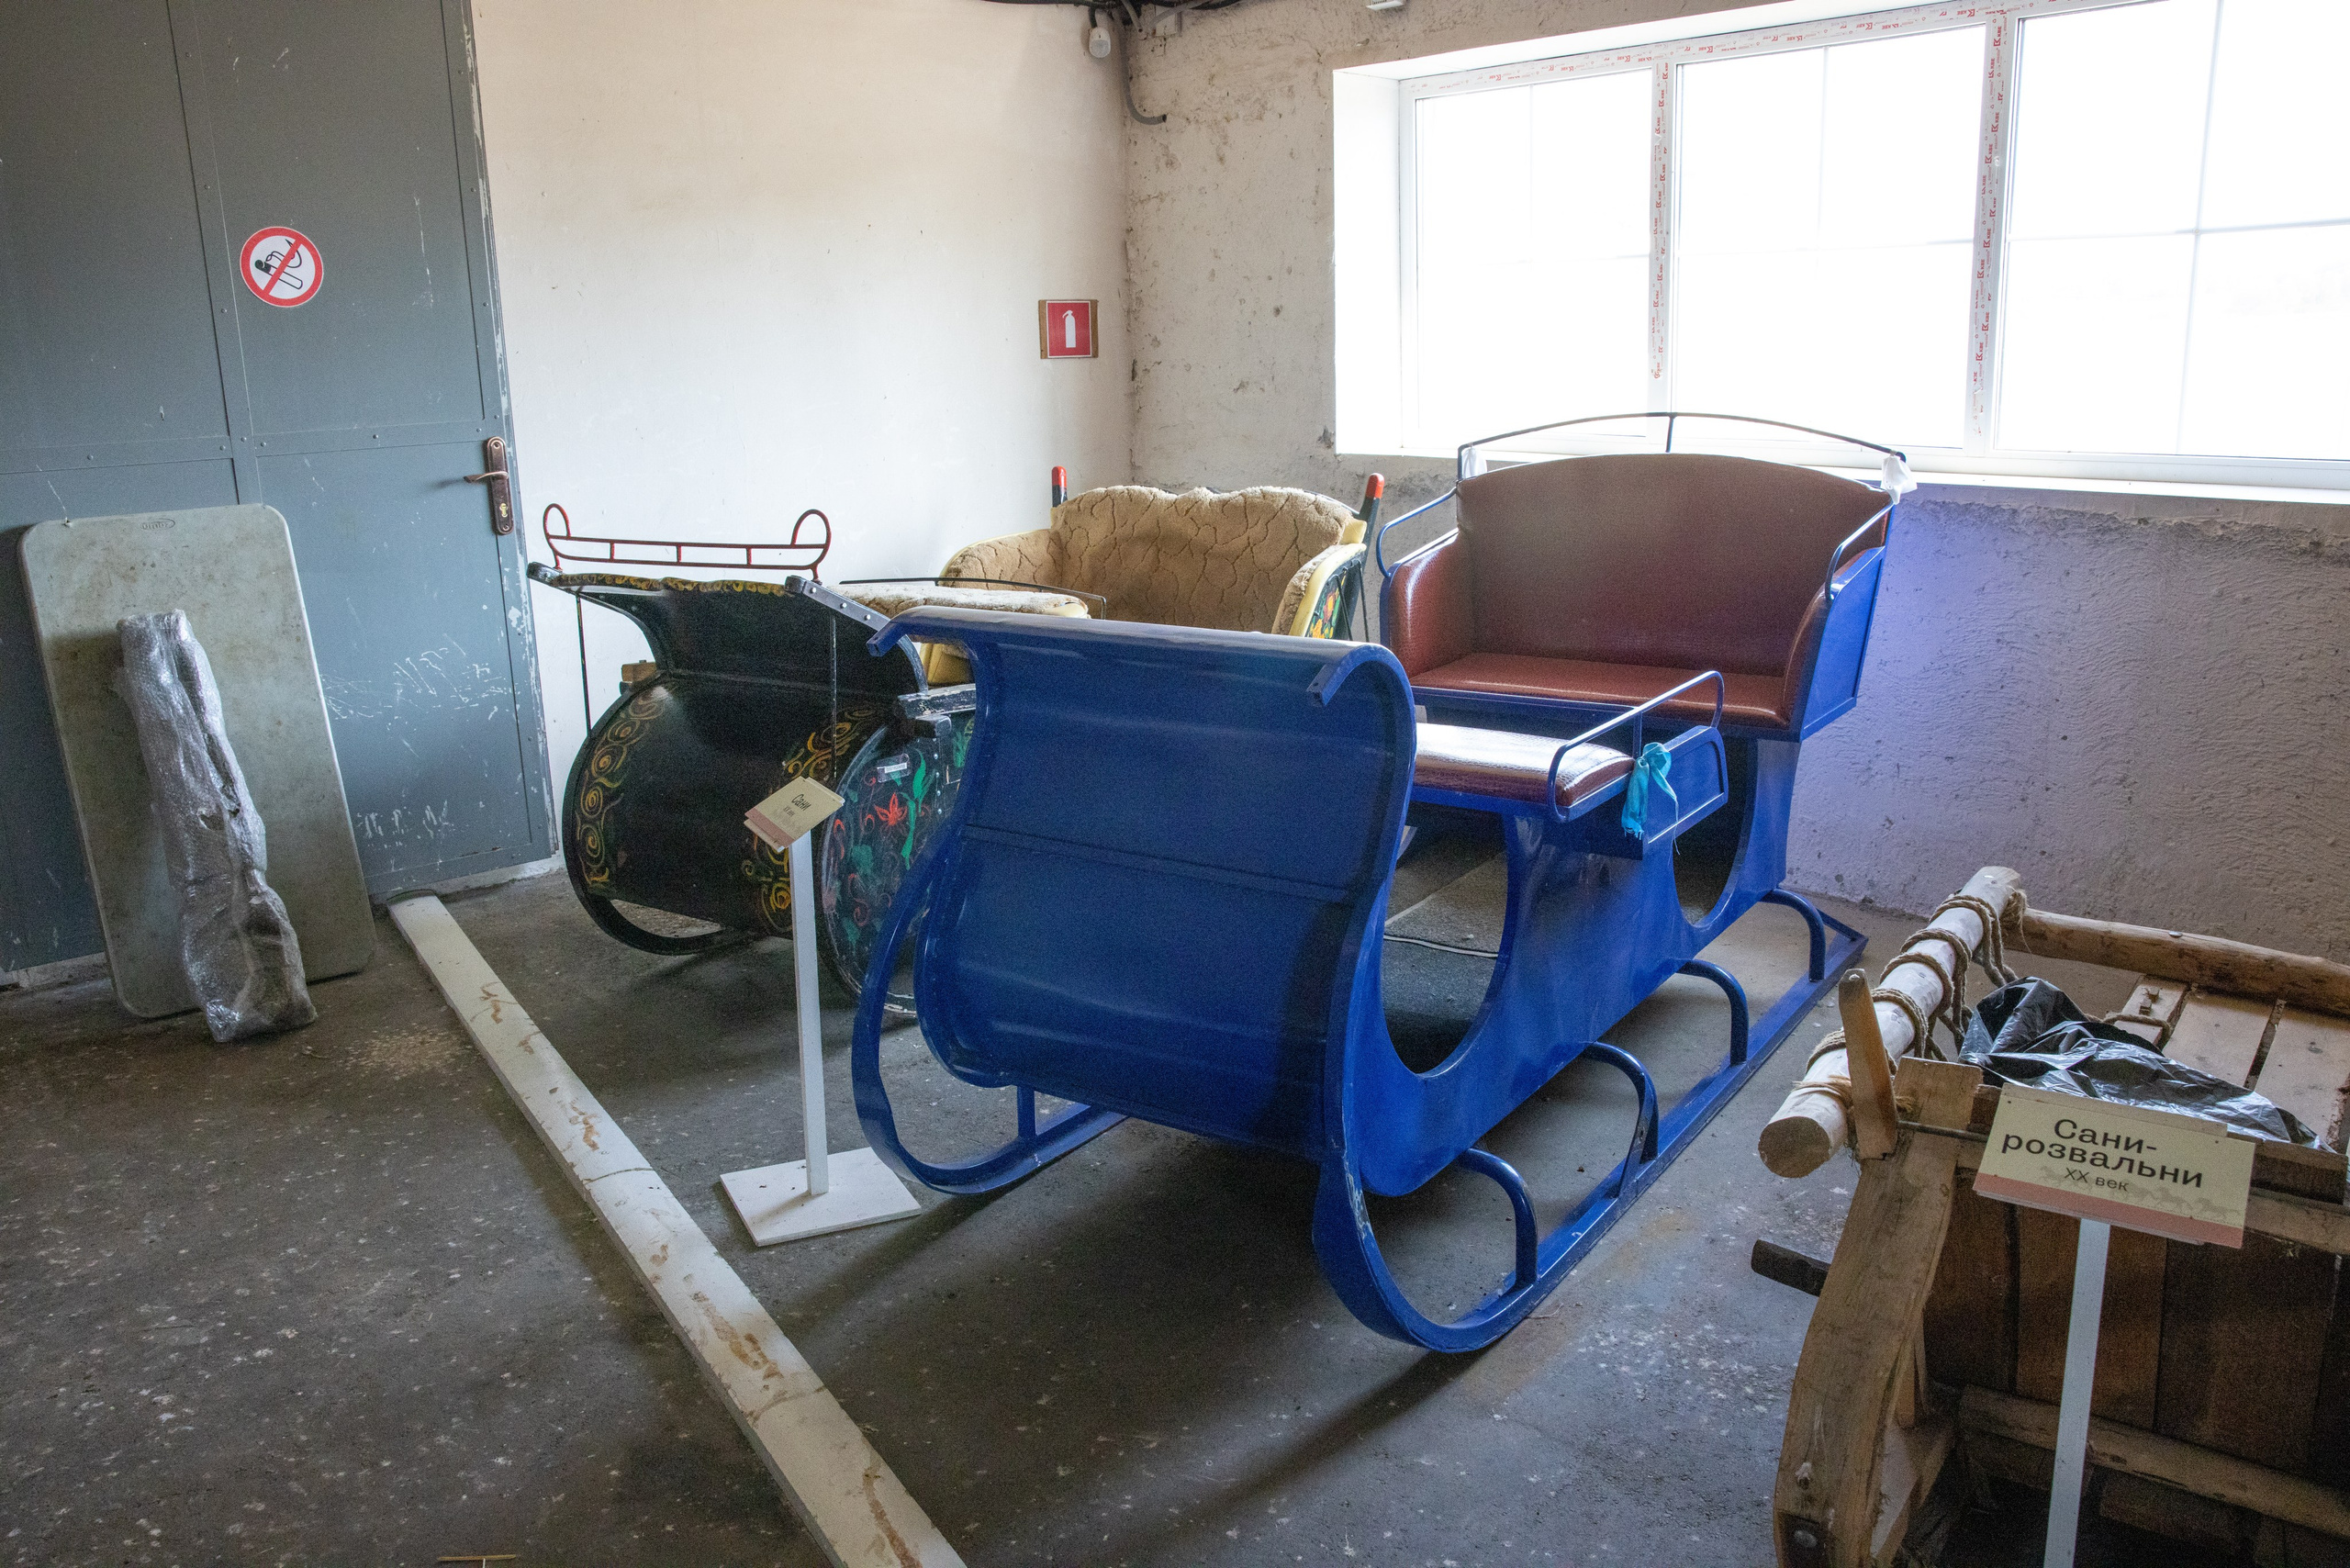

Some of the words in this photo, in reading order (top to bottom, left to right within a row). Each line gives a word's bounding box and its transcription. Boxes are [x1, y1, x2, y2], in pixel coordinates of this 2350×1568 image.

[791, 794, 811, 811] Сани
[2054, 1119, 2157, 1154] Сани-
[2001, 1134, 2203, 1188] розвальни
[2095, 1176, 2130, 1192] век
